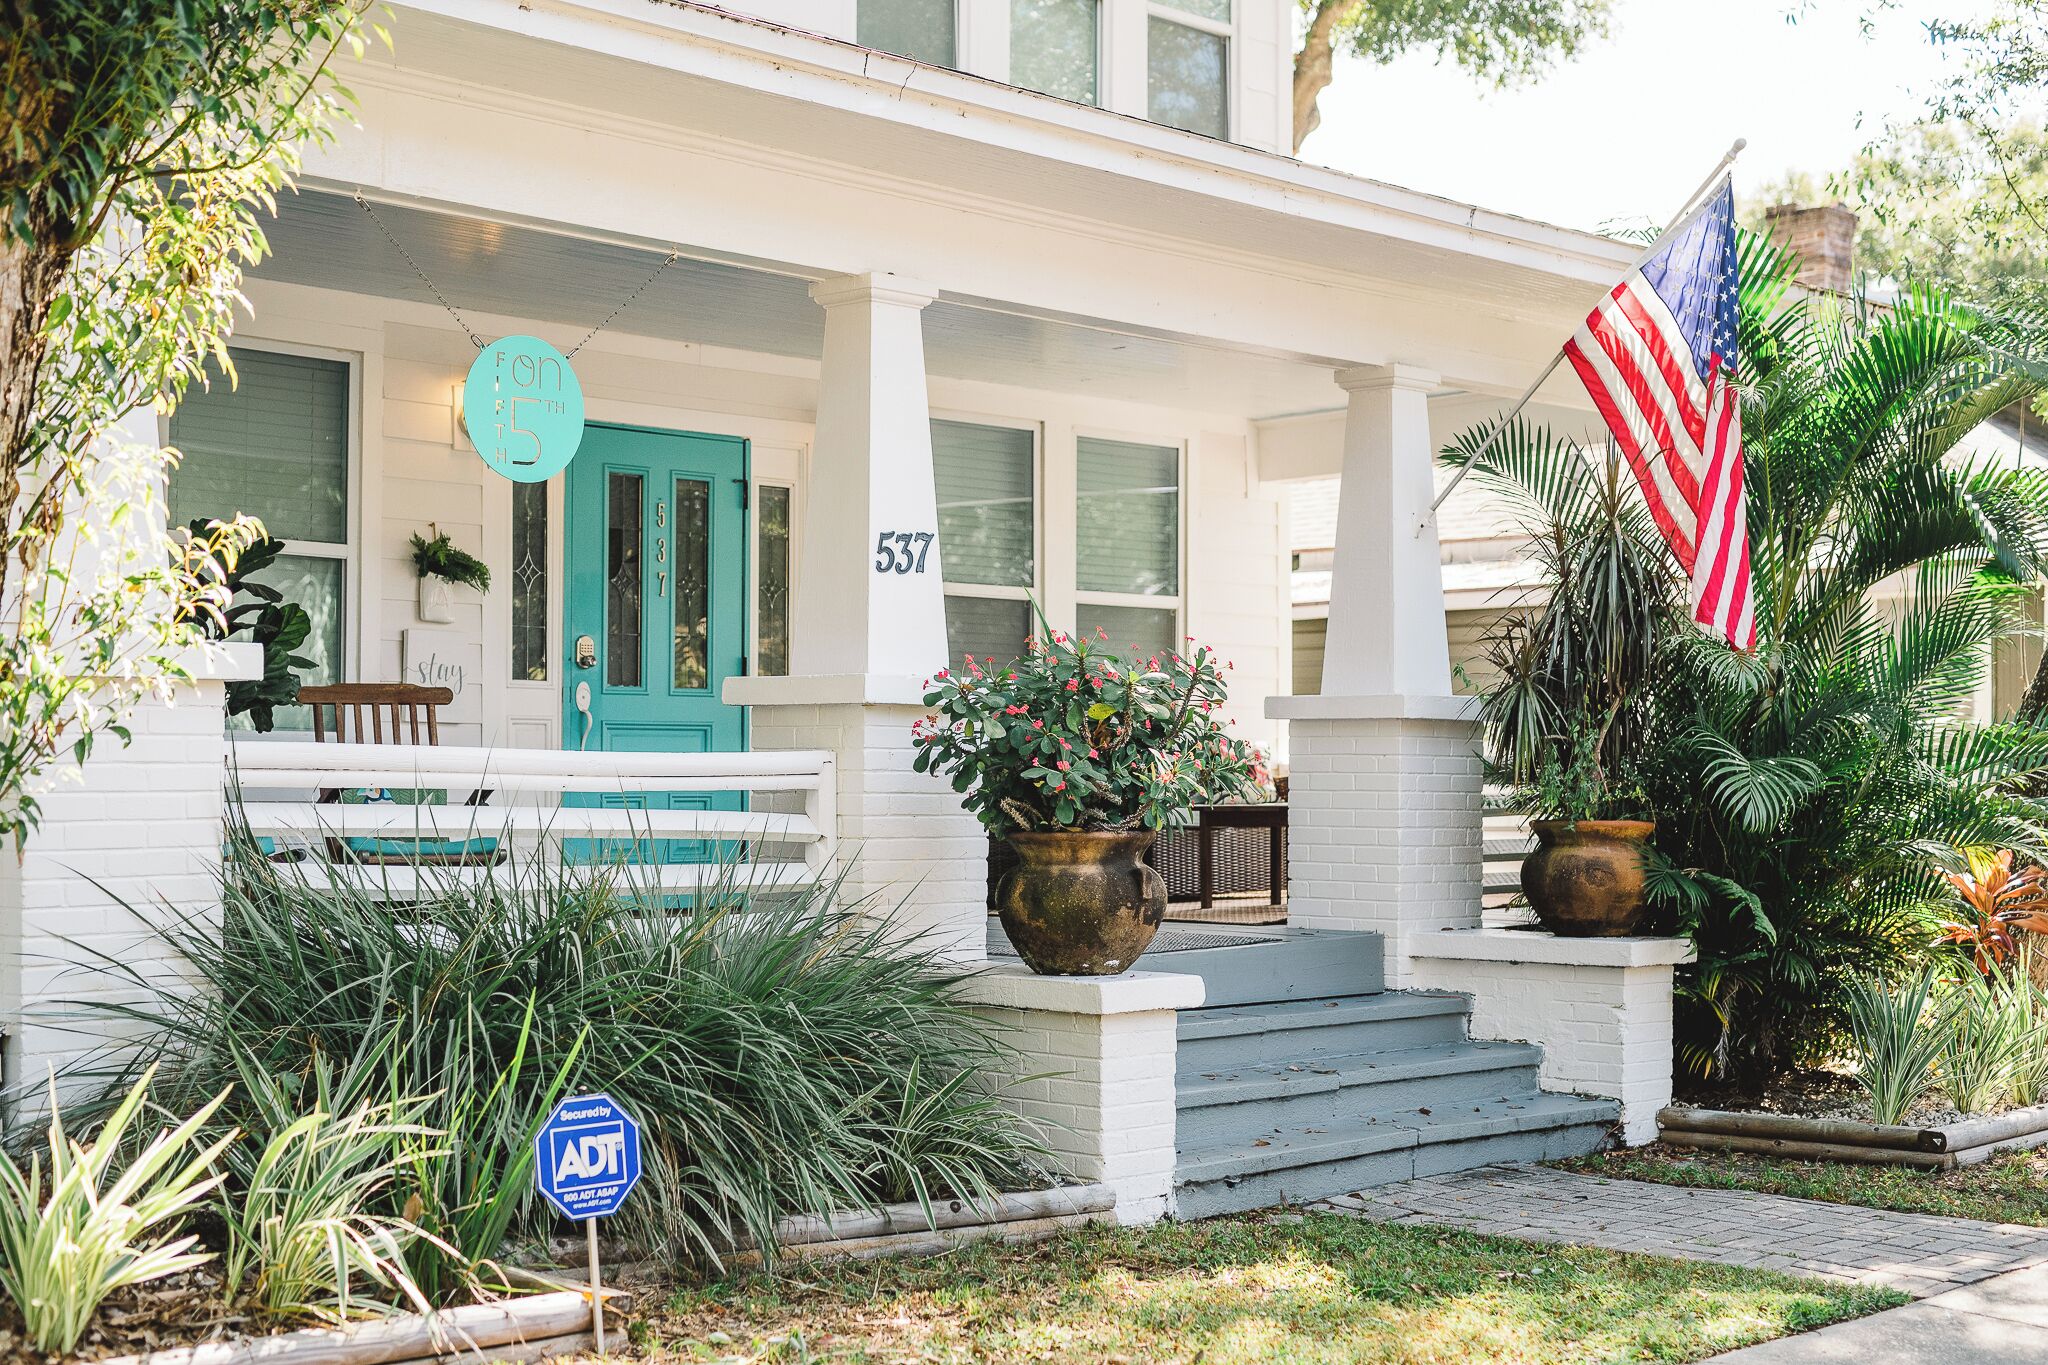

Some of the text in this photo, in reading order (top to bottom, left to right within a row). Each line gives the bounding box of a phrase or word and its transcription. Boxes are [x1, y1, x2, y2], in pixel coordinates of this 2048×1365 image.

[495, 351, 507, 465] FIFTH
[875, 530, 935, 575] 537
[416, 652, 467, 695] stay
[560, 1105, 612, 1122] Secured by
[556, 1131, 622, 1182] ADT
